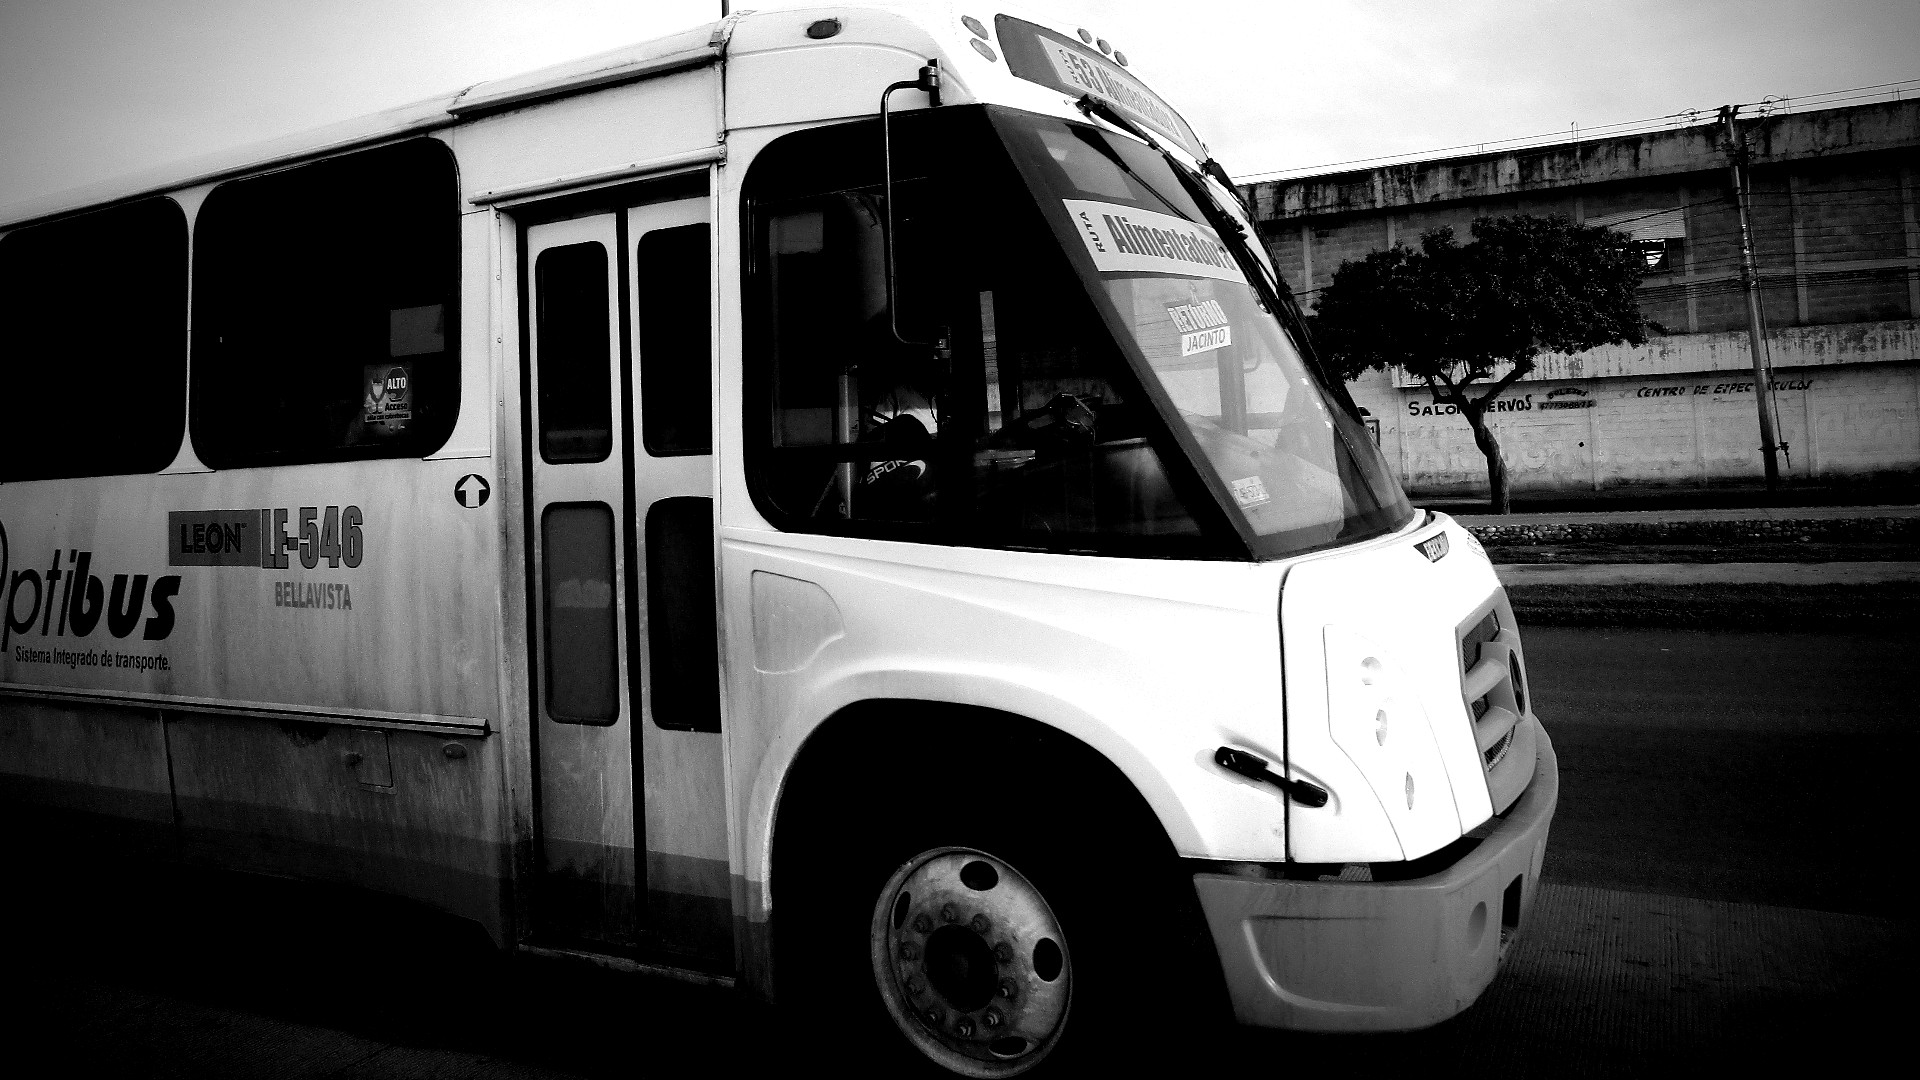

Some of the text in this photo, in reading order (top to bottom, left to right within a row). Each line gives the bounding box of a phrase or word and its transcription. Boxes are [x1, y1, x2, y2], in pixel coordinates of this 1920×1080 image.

[1067, 52, 1104, 94] 53
[1079, 211, 1106, 253] RUTA
[1102, 214, 1238, 271] Alimentadora
[1187, 329, 1226, 352] JACINTO
[387, 377, 406, 390] ALTO
[1637, 386, 1685, 398] CENTRO
[1693, 385, 1709, 395] DE
[1408, 401, 1460, 416] SALO
[261, 505, 363, 569] LE-546
[0, 516, 182, 653] ptibus
[275, 581, 353, 610] BELLAVISTA
[15, 645, 171, 673] Sistema Integrado de transporte.
